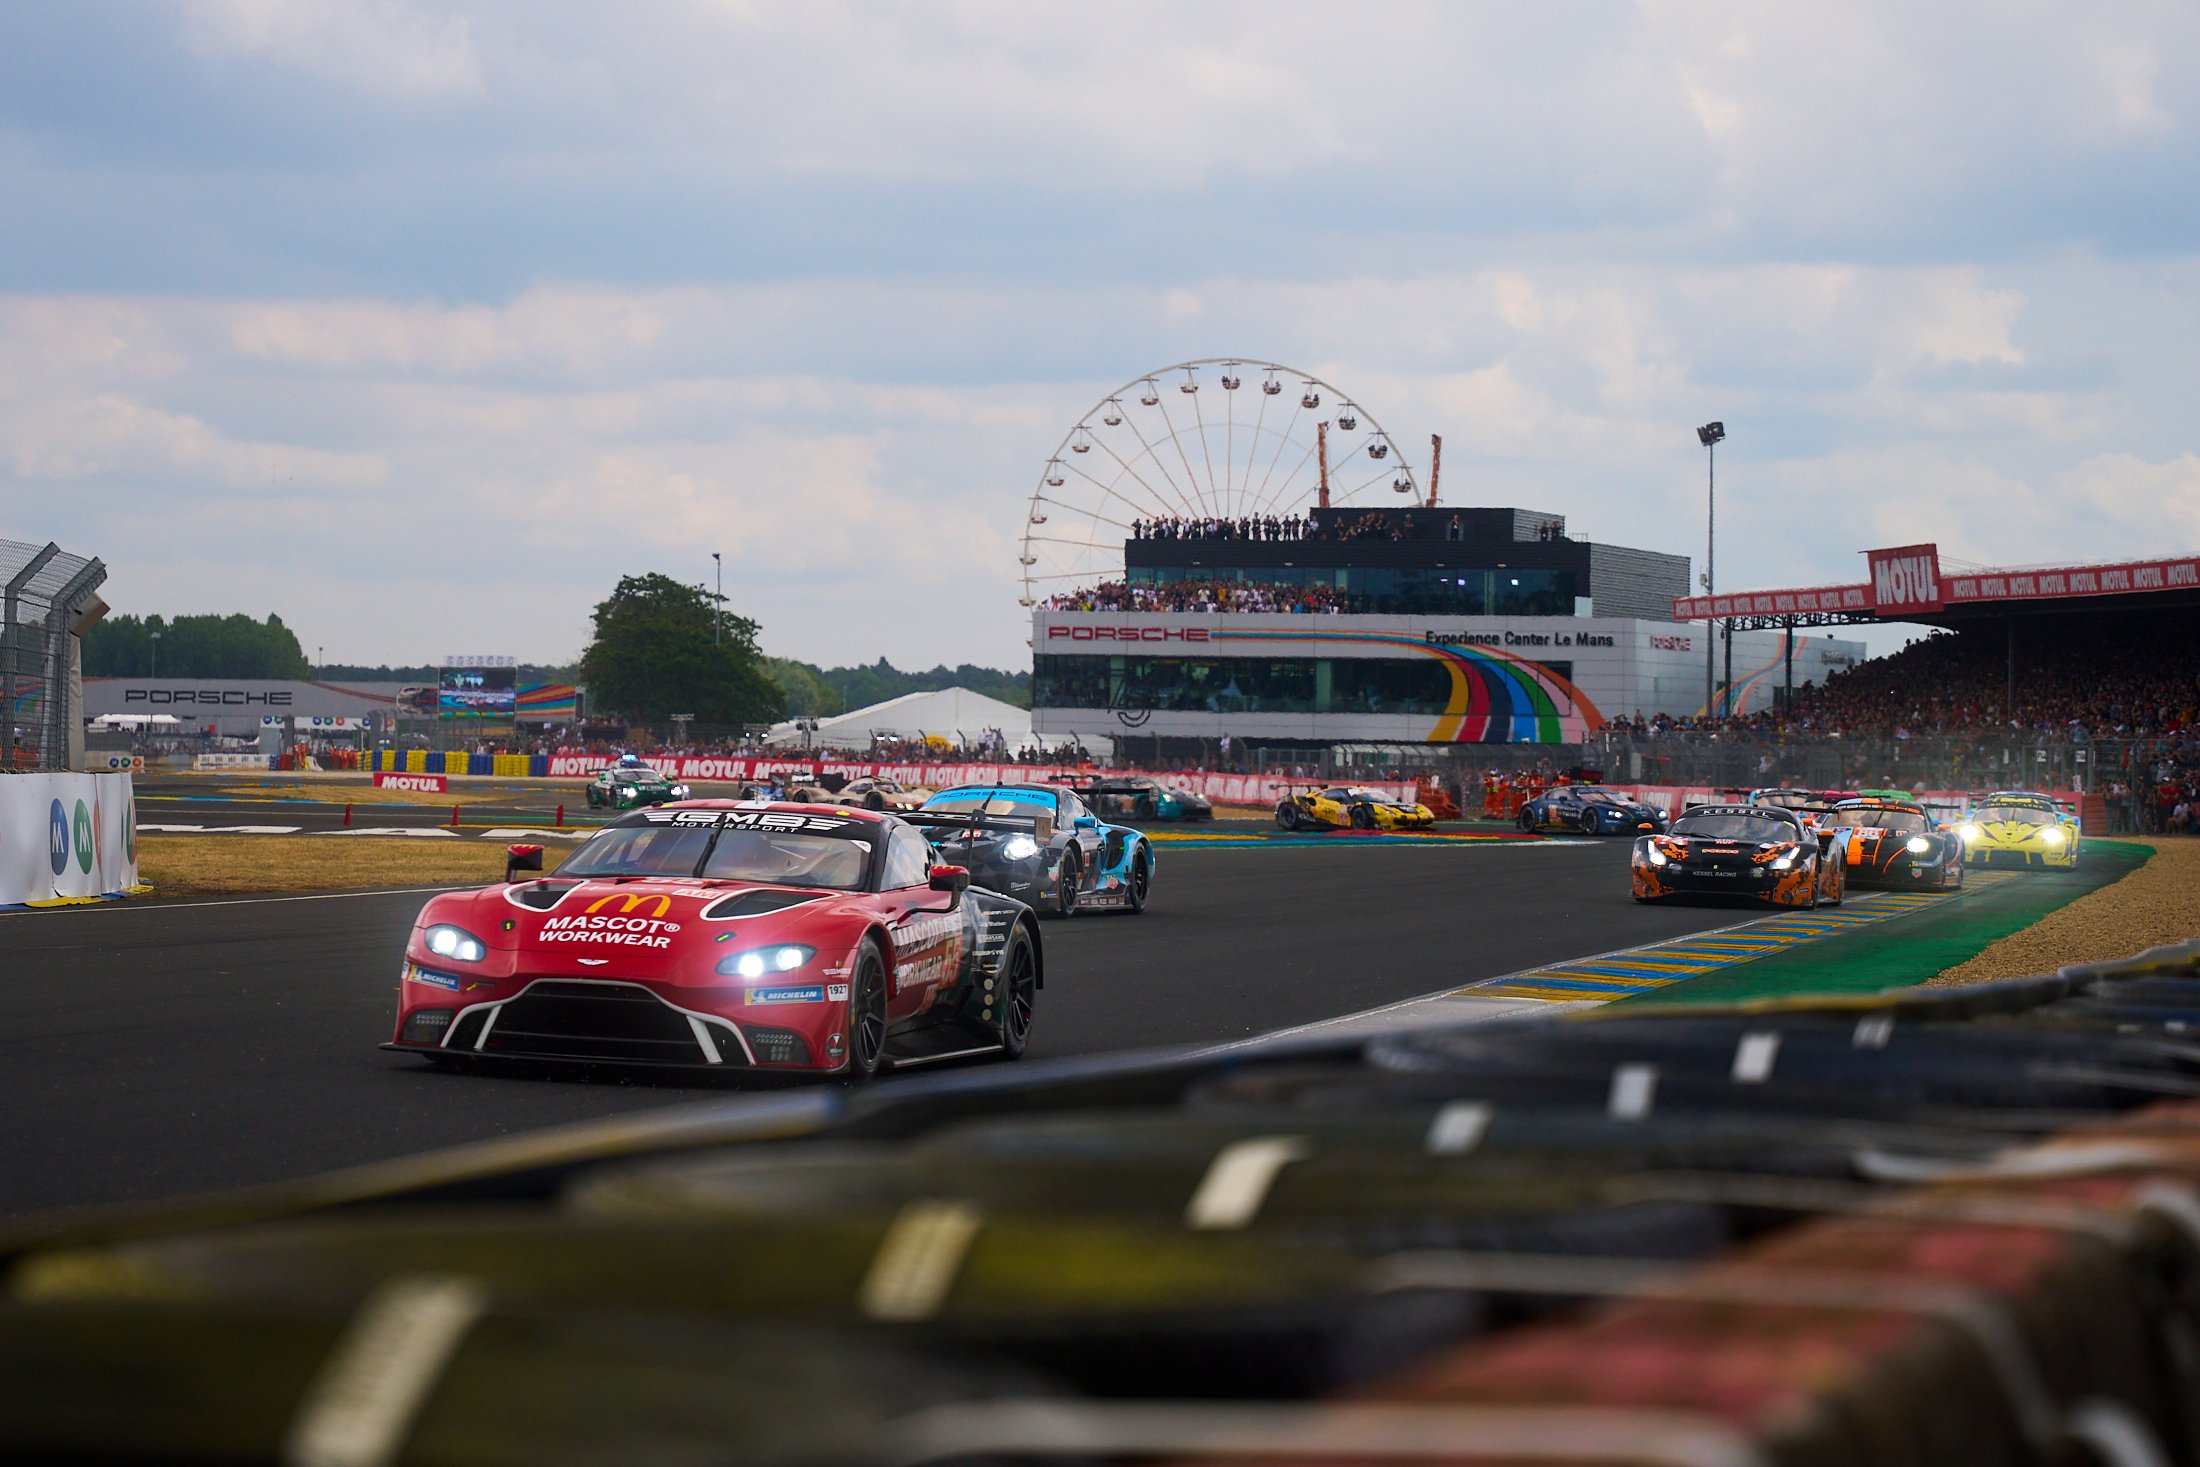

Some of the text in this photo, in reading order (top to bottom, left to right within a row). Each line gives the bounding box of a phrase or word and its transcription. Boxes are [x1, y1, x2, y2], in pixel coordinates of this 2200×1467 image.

[1875, 555, 1938, 605] MOTUL
[1953, 563, 2198, 598] MOTUL MOTUL MOTUL MOTUL MOTUL MOTUL MOTUL MOTUL
[1048, 627, 1209, 641] PORSCHE
[1425, 631, 1613, 647] Experience Center Le Mans
[125, 690, 292, 705] PORSCHE
[682, 760, 747, 778] MOTUL
[878, 766, 922, 785] MOTUL
[924, 767, 963, 786] MOTUL
[381, 777, 440, 791] MOTUL
[932, 791, 1050, 801] PORSCHE
[1703, 808, 1769, 818] KESSEL
[672, 821, 799, 833] MOTORSPORT
[538, 930, 671, 949] WORKWEAR
[423, 973, 456, 985] MICHELIN
[767, 991, 817, 999] MICHELIN
